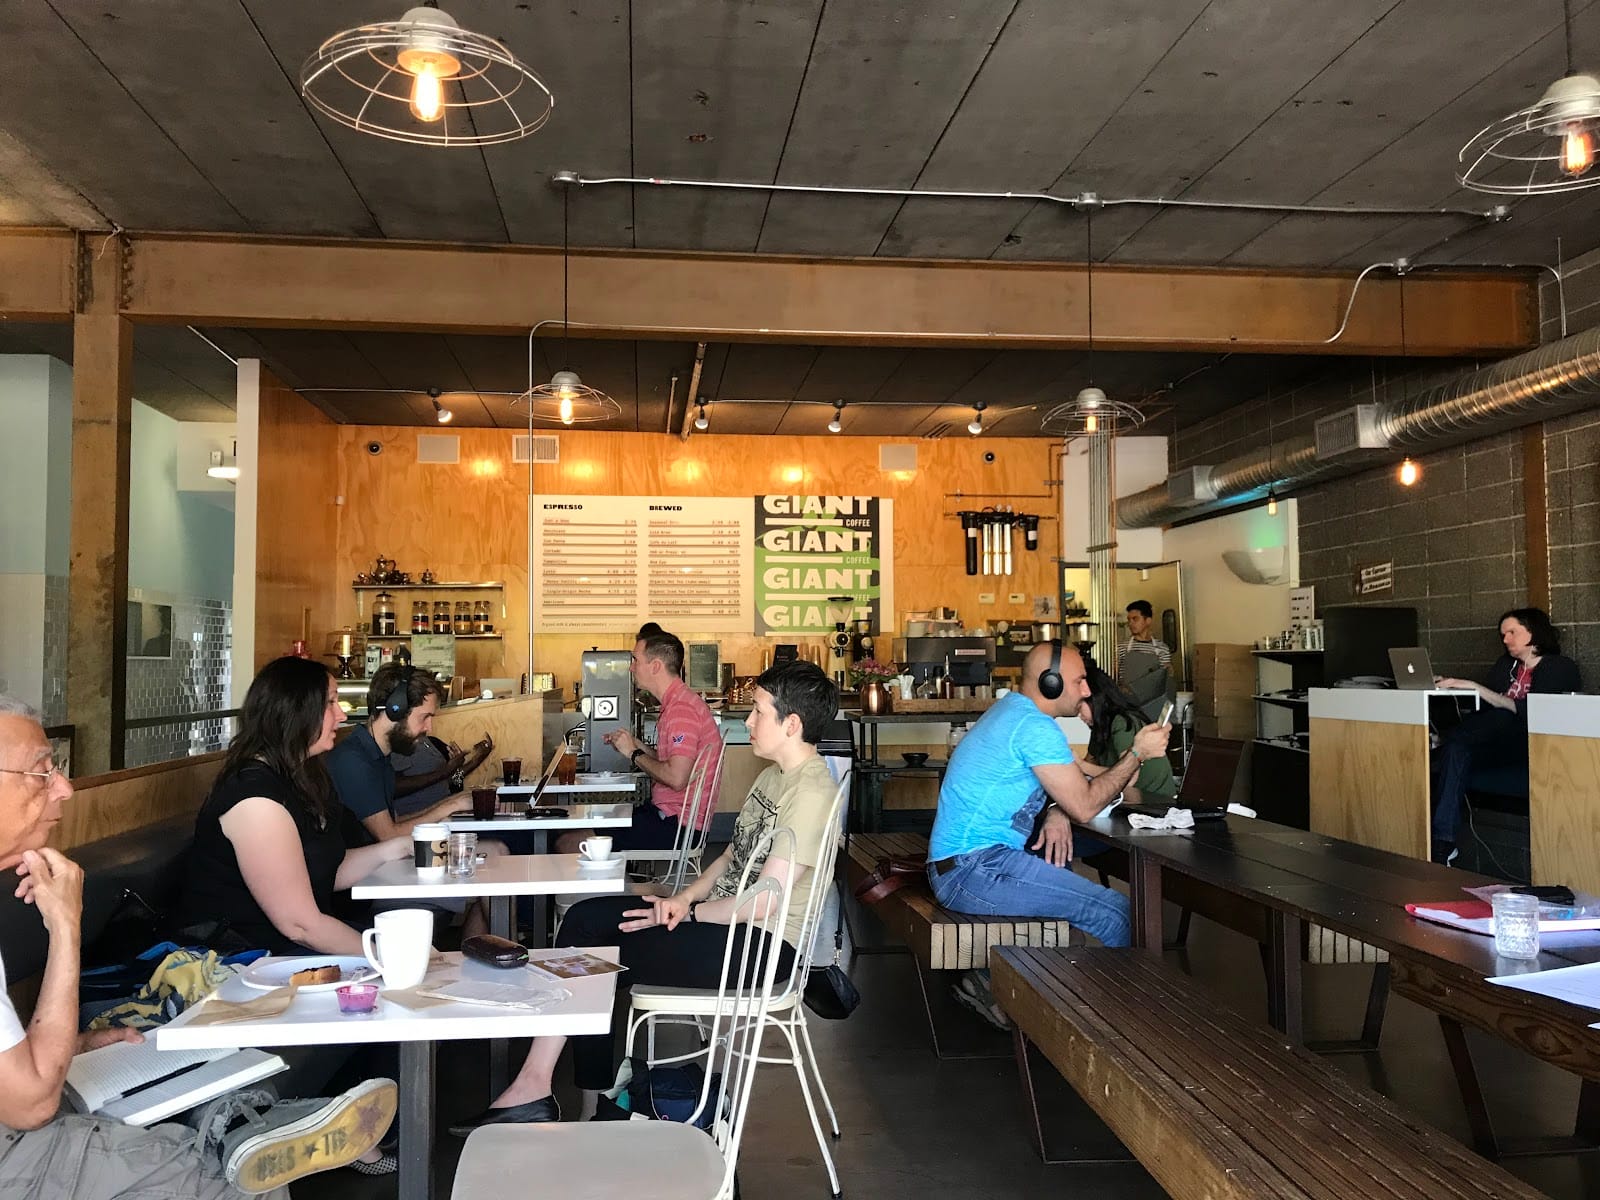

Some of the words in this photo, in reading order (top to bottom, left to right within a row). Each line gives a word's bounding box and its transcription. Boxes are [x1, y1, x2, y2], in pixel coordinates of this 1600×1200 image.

[763, 495, 872, 514] GIANT
[846, 519, 870, 527] COFFEE
[763, 530, 872, 552] GIANT
[846, 556, 870, 564] COFFEE
[763, 568, 872, 590] GIANT
[763, 605, 872, 627] GIANT
